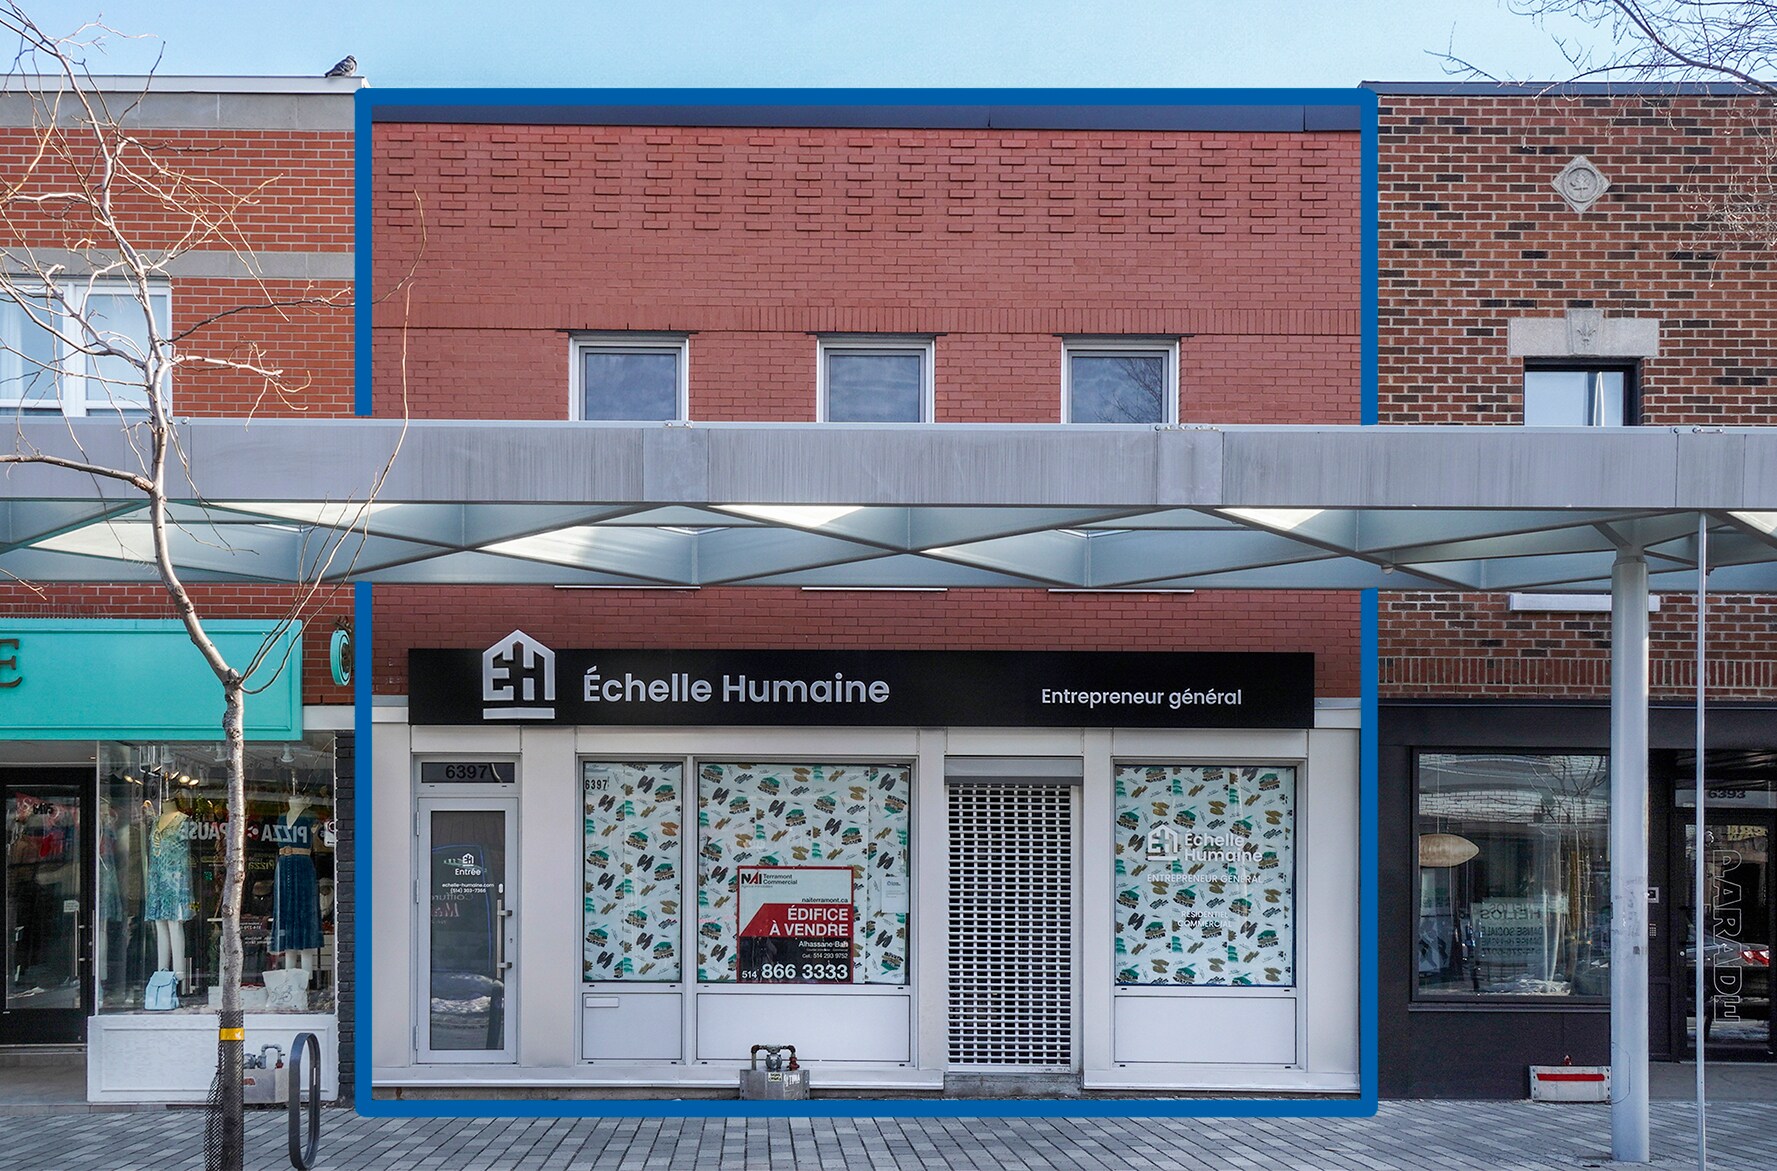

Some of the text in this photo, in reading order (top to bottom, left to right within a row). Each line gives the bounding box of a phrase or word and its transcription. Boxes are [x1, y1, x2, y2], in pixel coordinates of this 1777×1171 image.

[583, 665, 890, 703] Échelle Humaine
[1041, 688, 1242, 710] Entrepreneur général
[445, 764, 488, 779] 6397
[585, 779, 608, 791] 6397
[1708, 789, 1746, 799] 6393
[1184, 829, 1245, 847] Échelle
[1184, 848, 1263, 862] Humaine
[455, 868, 481, 876] Entrée
[741, 872, 762, 884] NAI
[1147, 874, 1218, 883] ENTREPRENEUR
[788, 905, 848, 921] ÉDIFICE
[769, 920, 848, 936] À VENDRE
[1178, 920, 1232, 928] COMMERCIAL
[1713, 850, 1743, 1023] PARADE
[742, 964, 848, 979] 514 866 3333
